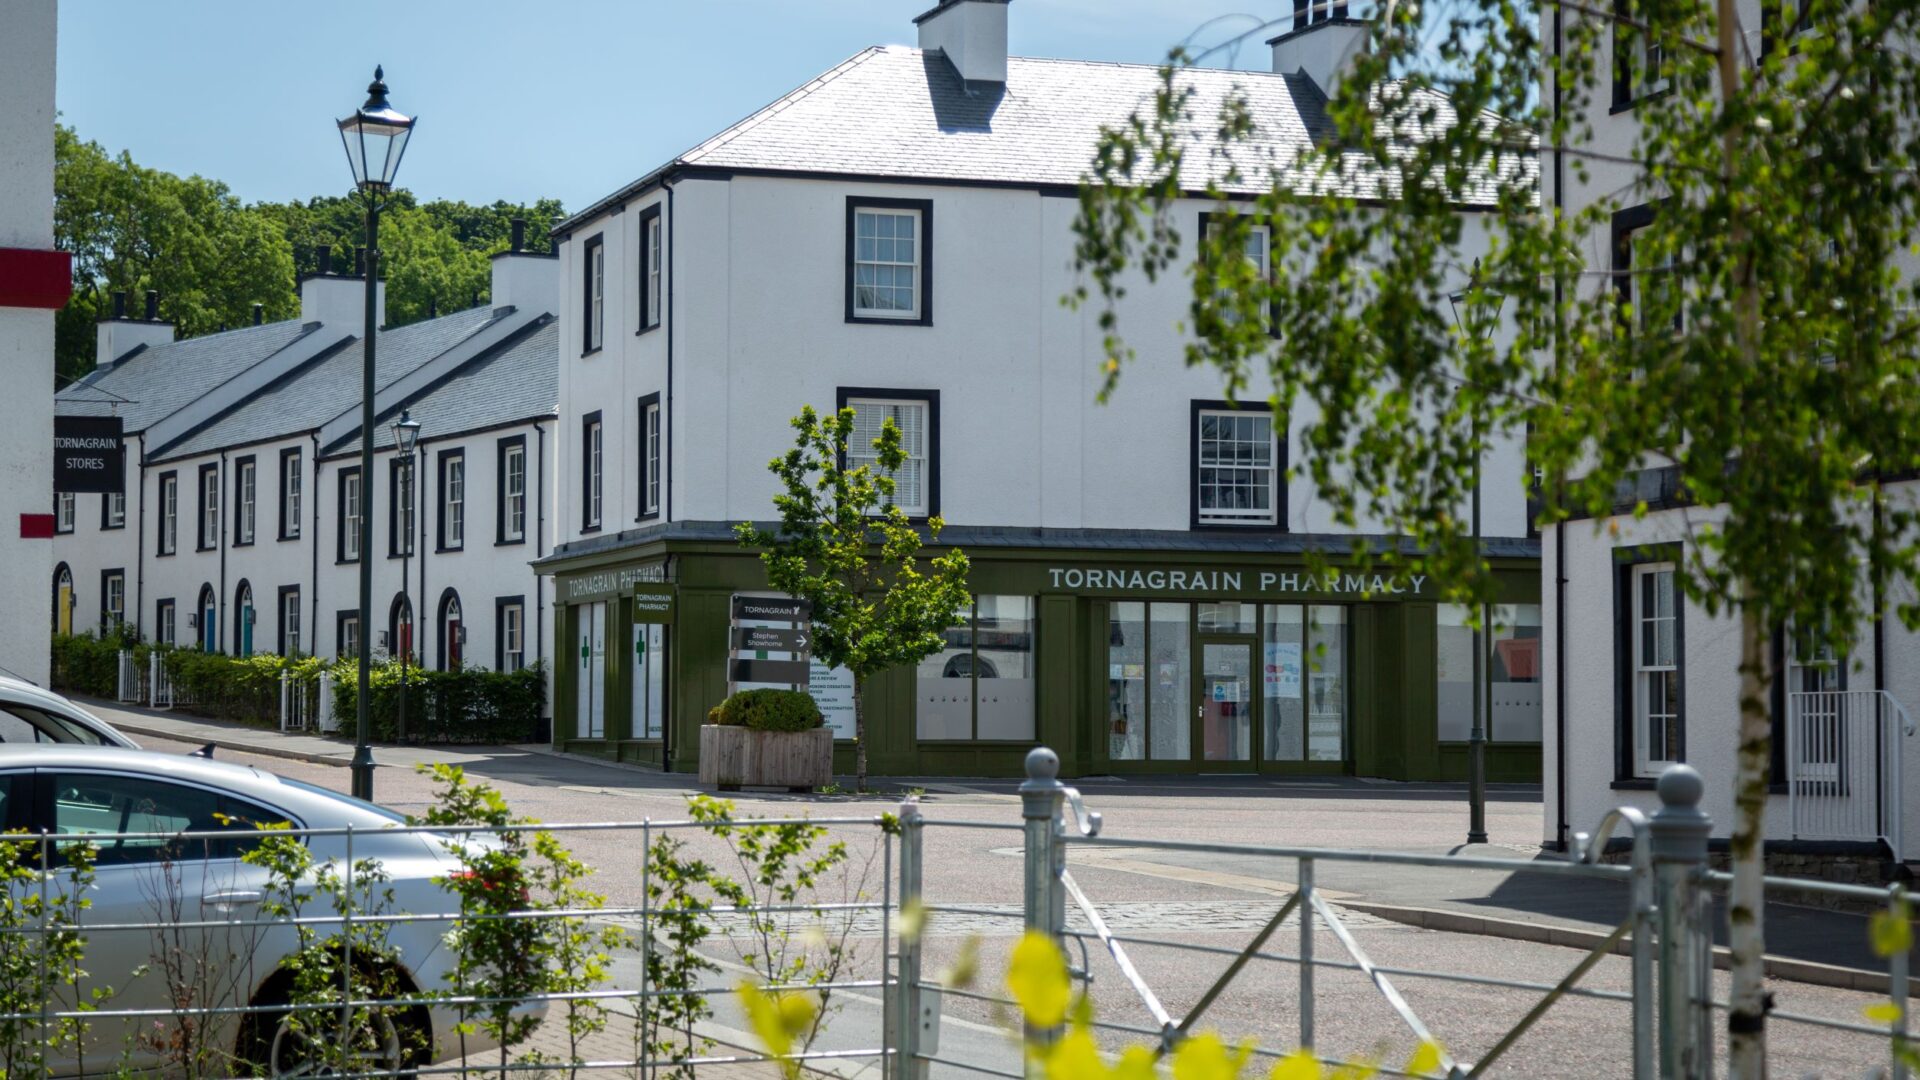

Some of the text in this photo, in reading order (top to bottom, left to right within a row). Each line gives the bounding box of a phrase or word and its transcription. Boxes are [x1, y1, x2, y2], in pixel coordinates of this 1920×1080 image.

[54, 437, 117, 449] TORNAGRAIN
[66, 457, 105, 469] STORES
[569, 572, 617, 597] TORNAGRAIN
[1048, 568, 1426, 594] TORNAGRAIN PHARMACY
[636, 593, 672, 602] TORNAGRAIN
[638, 603, 669, 611] PHARMACY
[744, 606, 792, 615] TORNAGRAIN
[752, 632, 779, 640] Stephen
[747, 639, 783, 647] Showhome
